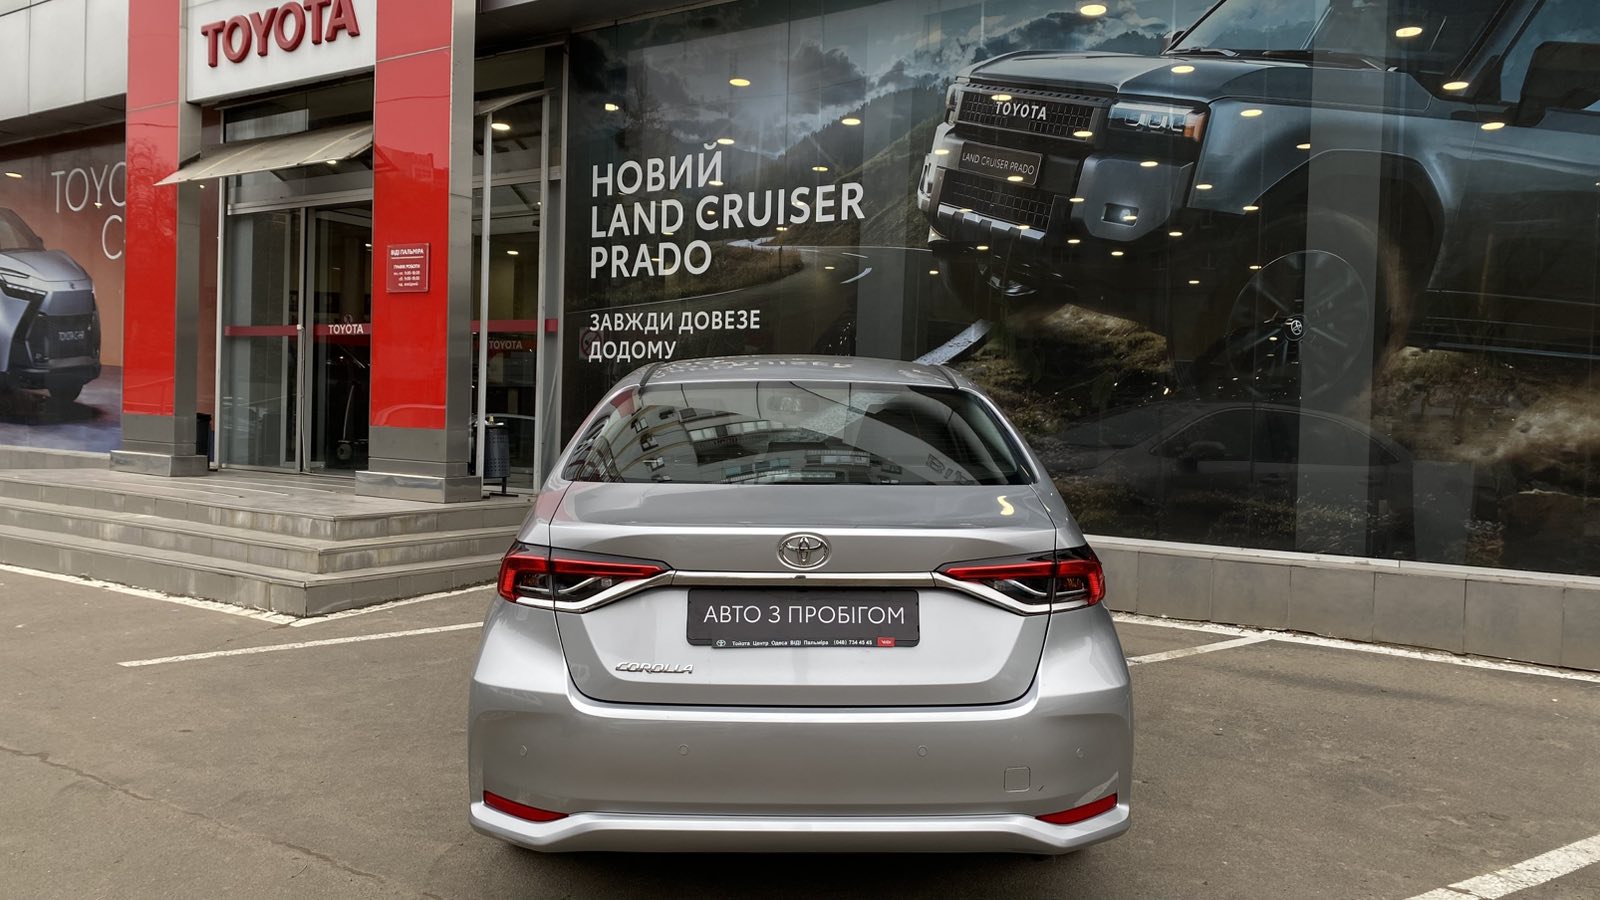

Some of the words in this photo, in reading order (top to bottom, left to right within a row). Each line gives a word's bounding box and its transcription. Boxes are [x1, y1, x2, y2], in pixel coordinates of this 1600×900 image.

[201, 0, 360, 68] TOYOTA
[996, 101, 1047, 120] TOYOTA
[592, 142, 722, 197] НОВИЙ
[962, 153, 980, 164] LAND
[981, 156, 1008, 169] CRUISER
[1009, 161, 1035, 175] PRADO
[591, 199, 684, 238] LAND
[696, 182, 866, 231] CRUISER
[590, 240, 712, 279] PRADO
[328, 324, 364, 335] TOYOTA
[589, 312, 673, 334] ЗАВЖДИ
[679, 309, 761, 334] ДОВЕЗЕ
[489, 340, 523, 349] TOYOTA
[588, 340, 677, 363] ДОДОМУ
[704, 605, 761, 623] АВТО
[768, 605, 781, 623] З
[788, 605, 905, 624] ПРОБІГОМ
[615, 662, 694, 674] COROLLA
